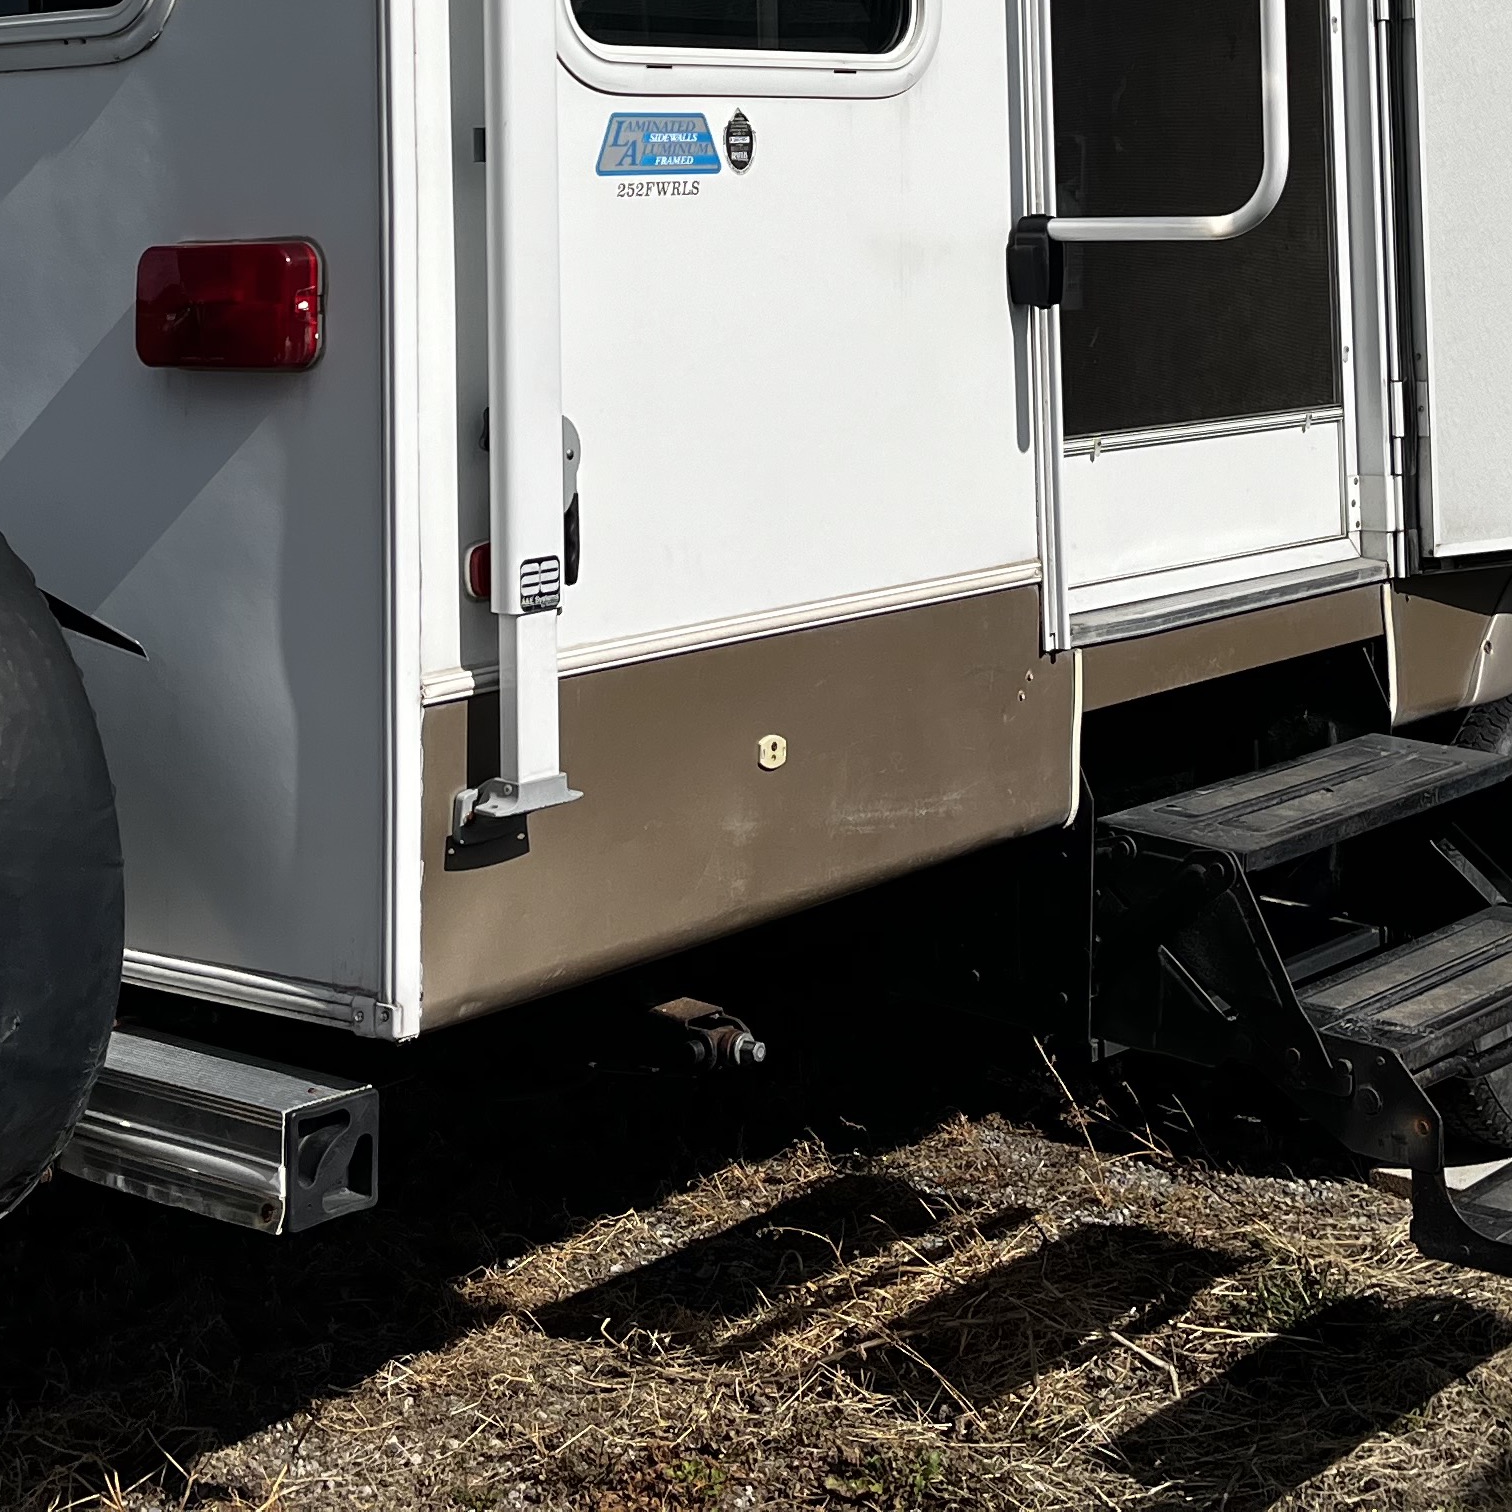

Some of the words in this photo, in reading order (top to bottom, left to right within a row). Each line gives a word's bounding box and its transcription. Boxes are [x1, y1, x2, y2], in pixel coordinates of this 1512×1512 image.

[609, 119, 696, 148] LAMINATED
[648, 132, 698, 143] SIDEWALLS
[615, 139, 710, 167] ALUMINUM
[654, 155, 695, 166] FRAMED
[616, 180, 701, 198] 252FWRLS
